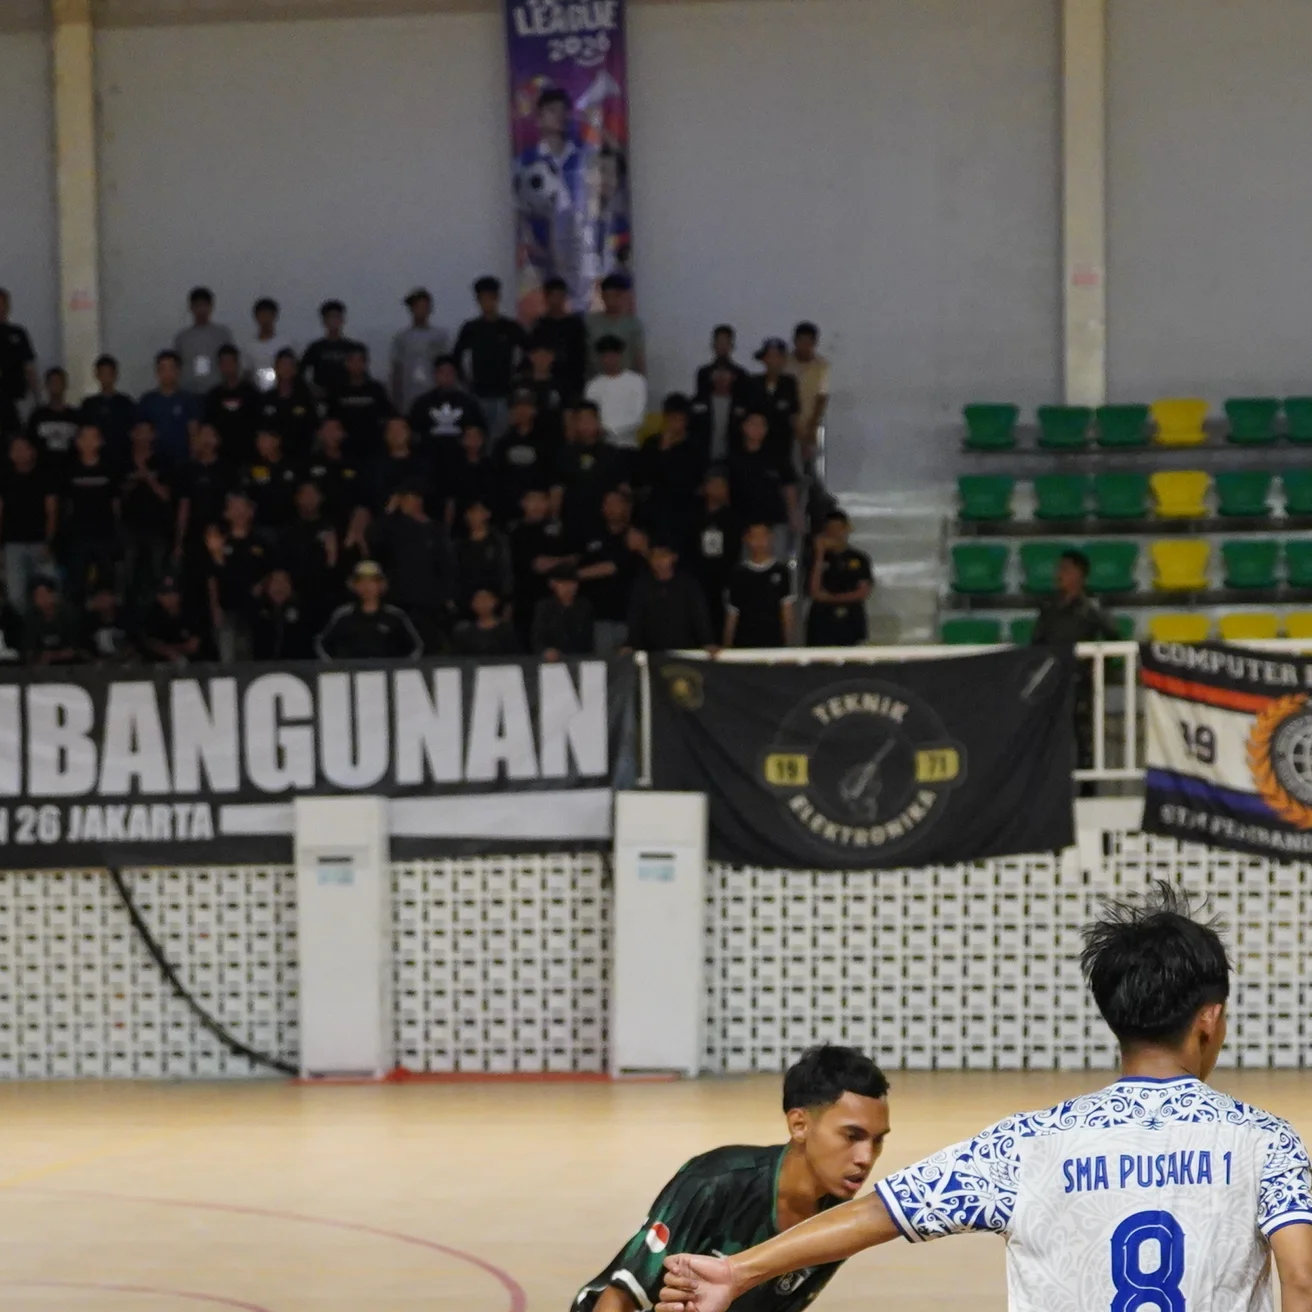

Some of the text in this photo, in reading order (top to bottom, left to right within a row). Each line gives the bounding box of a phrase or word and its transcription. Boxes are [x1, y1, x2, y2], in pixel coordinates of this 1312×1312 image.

[1152, 644, 1297, 687] COMPUTER
[812, 692, 909, 726] TEKNIK
[1179, 720, 1217, 765] 19
[14, 805, 60, 844] 26
[66, 803, 215, 843] JAKARTA
[789, 789, 937, 848] ELEKTRONIKA
[1062, 1150, 1233, 1193] SMA PUSAKA 1
